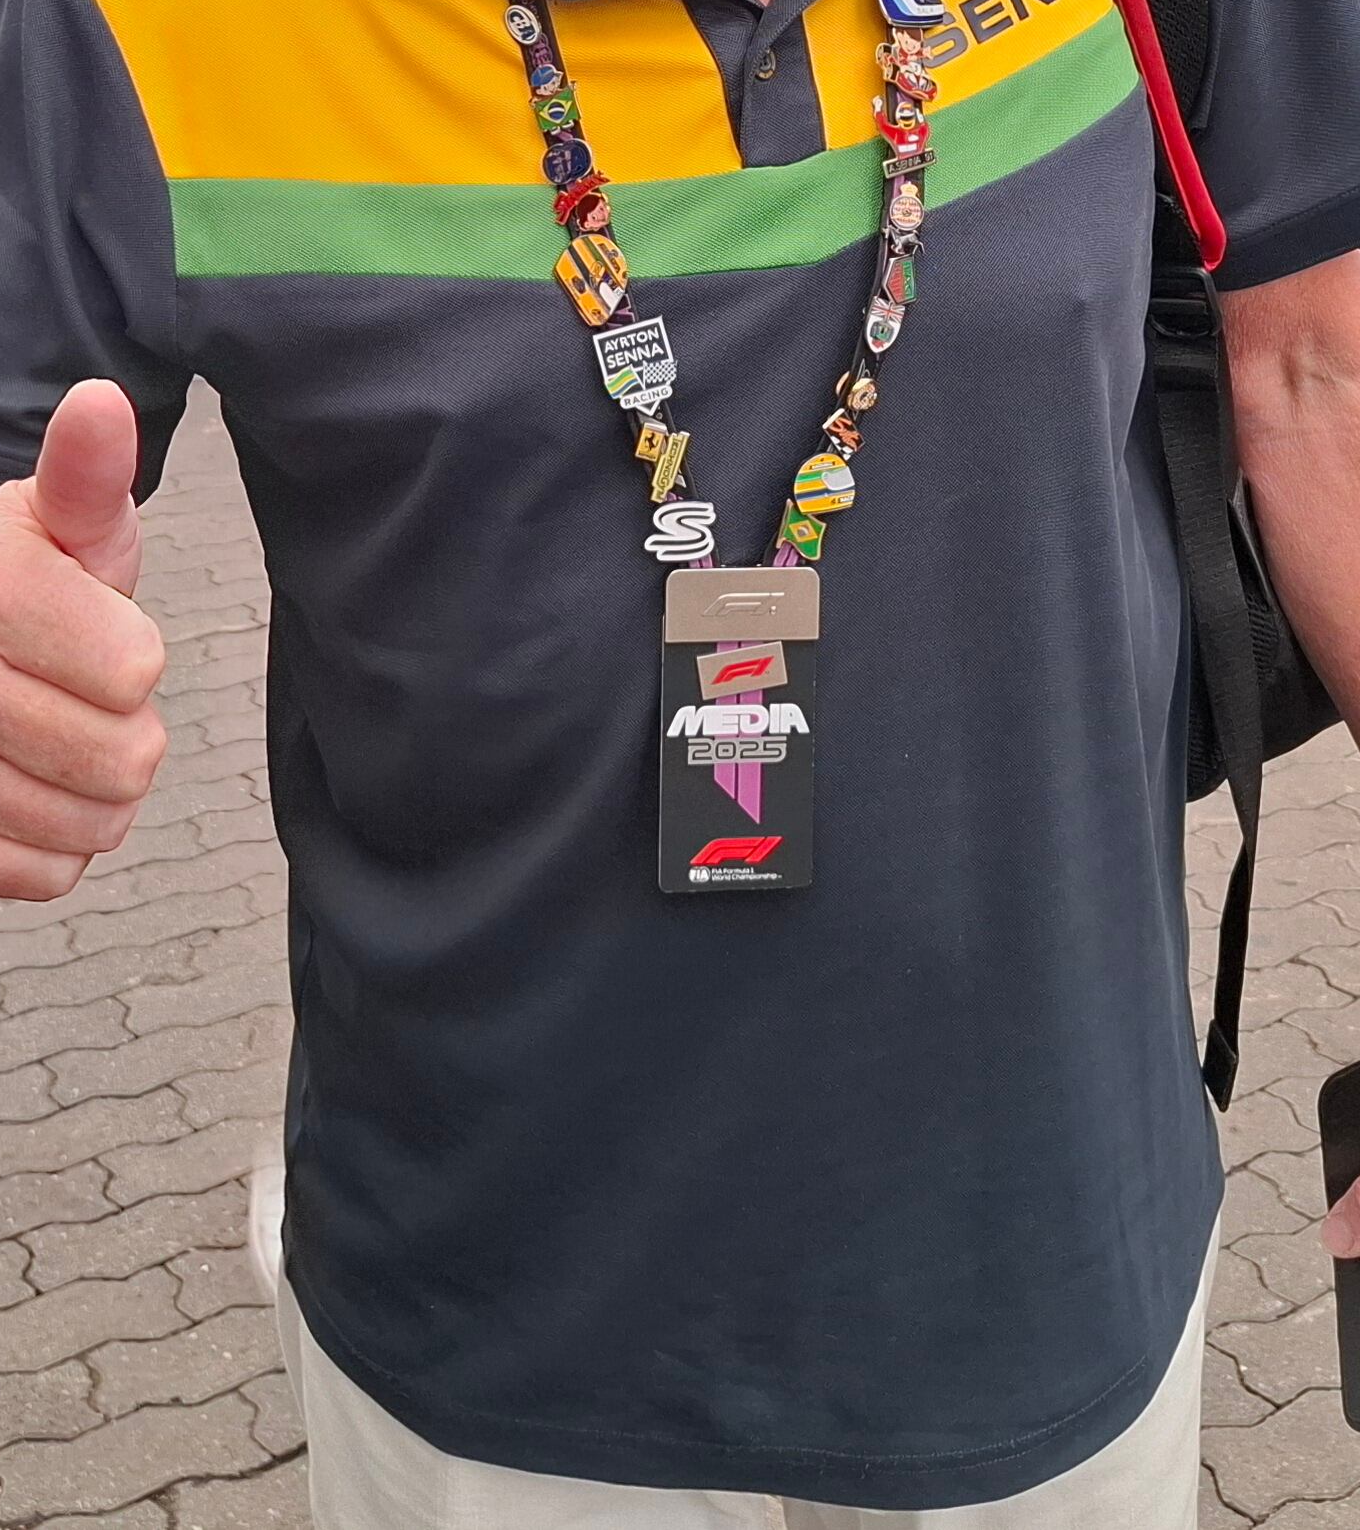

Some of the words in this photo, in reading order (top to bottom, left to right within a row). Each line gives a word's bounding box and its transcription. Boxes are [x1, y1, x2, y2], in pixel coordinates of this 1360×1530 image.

[603, 327, 661, 354] AYRTON
[606, 343, 665, 370] SENNA
[623, 387, 670, 407] RACING
[666, 703, 810, 737] MEDIA
[687, 737, 788, 765] 2025
[690, 868, 709, 881] FIA
